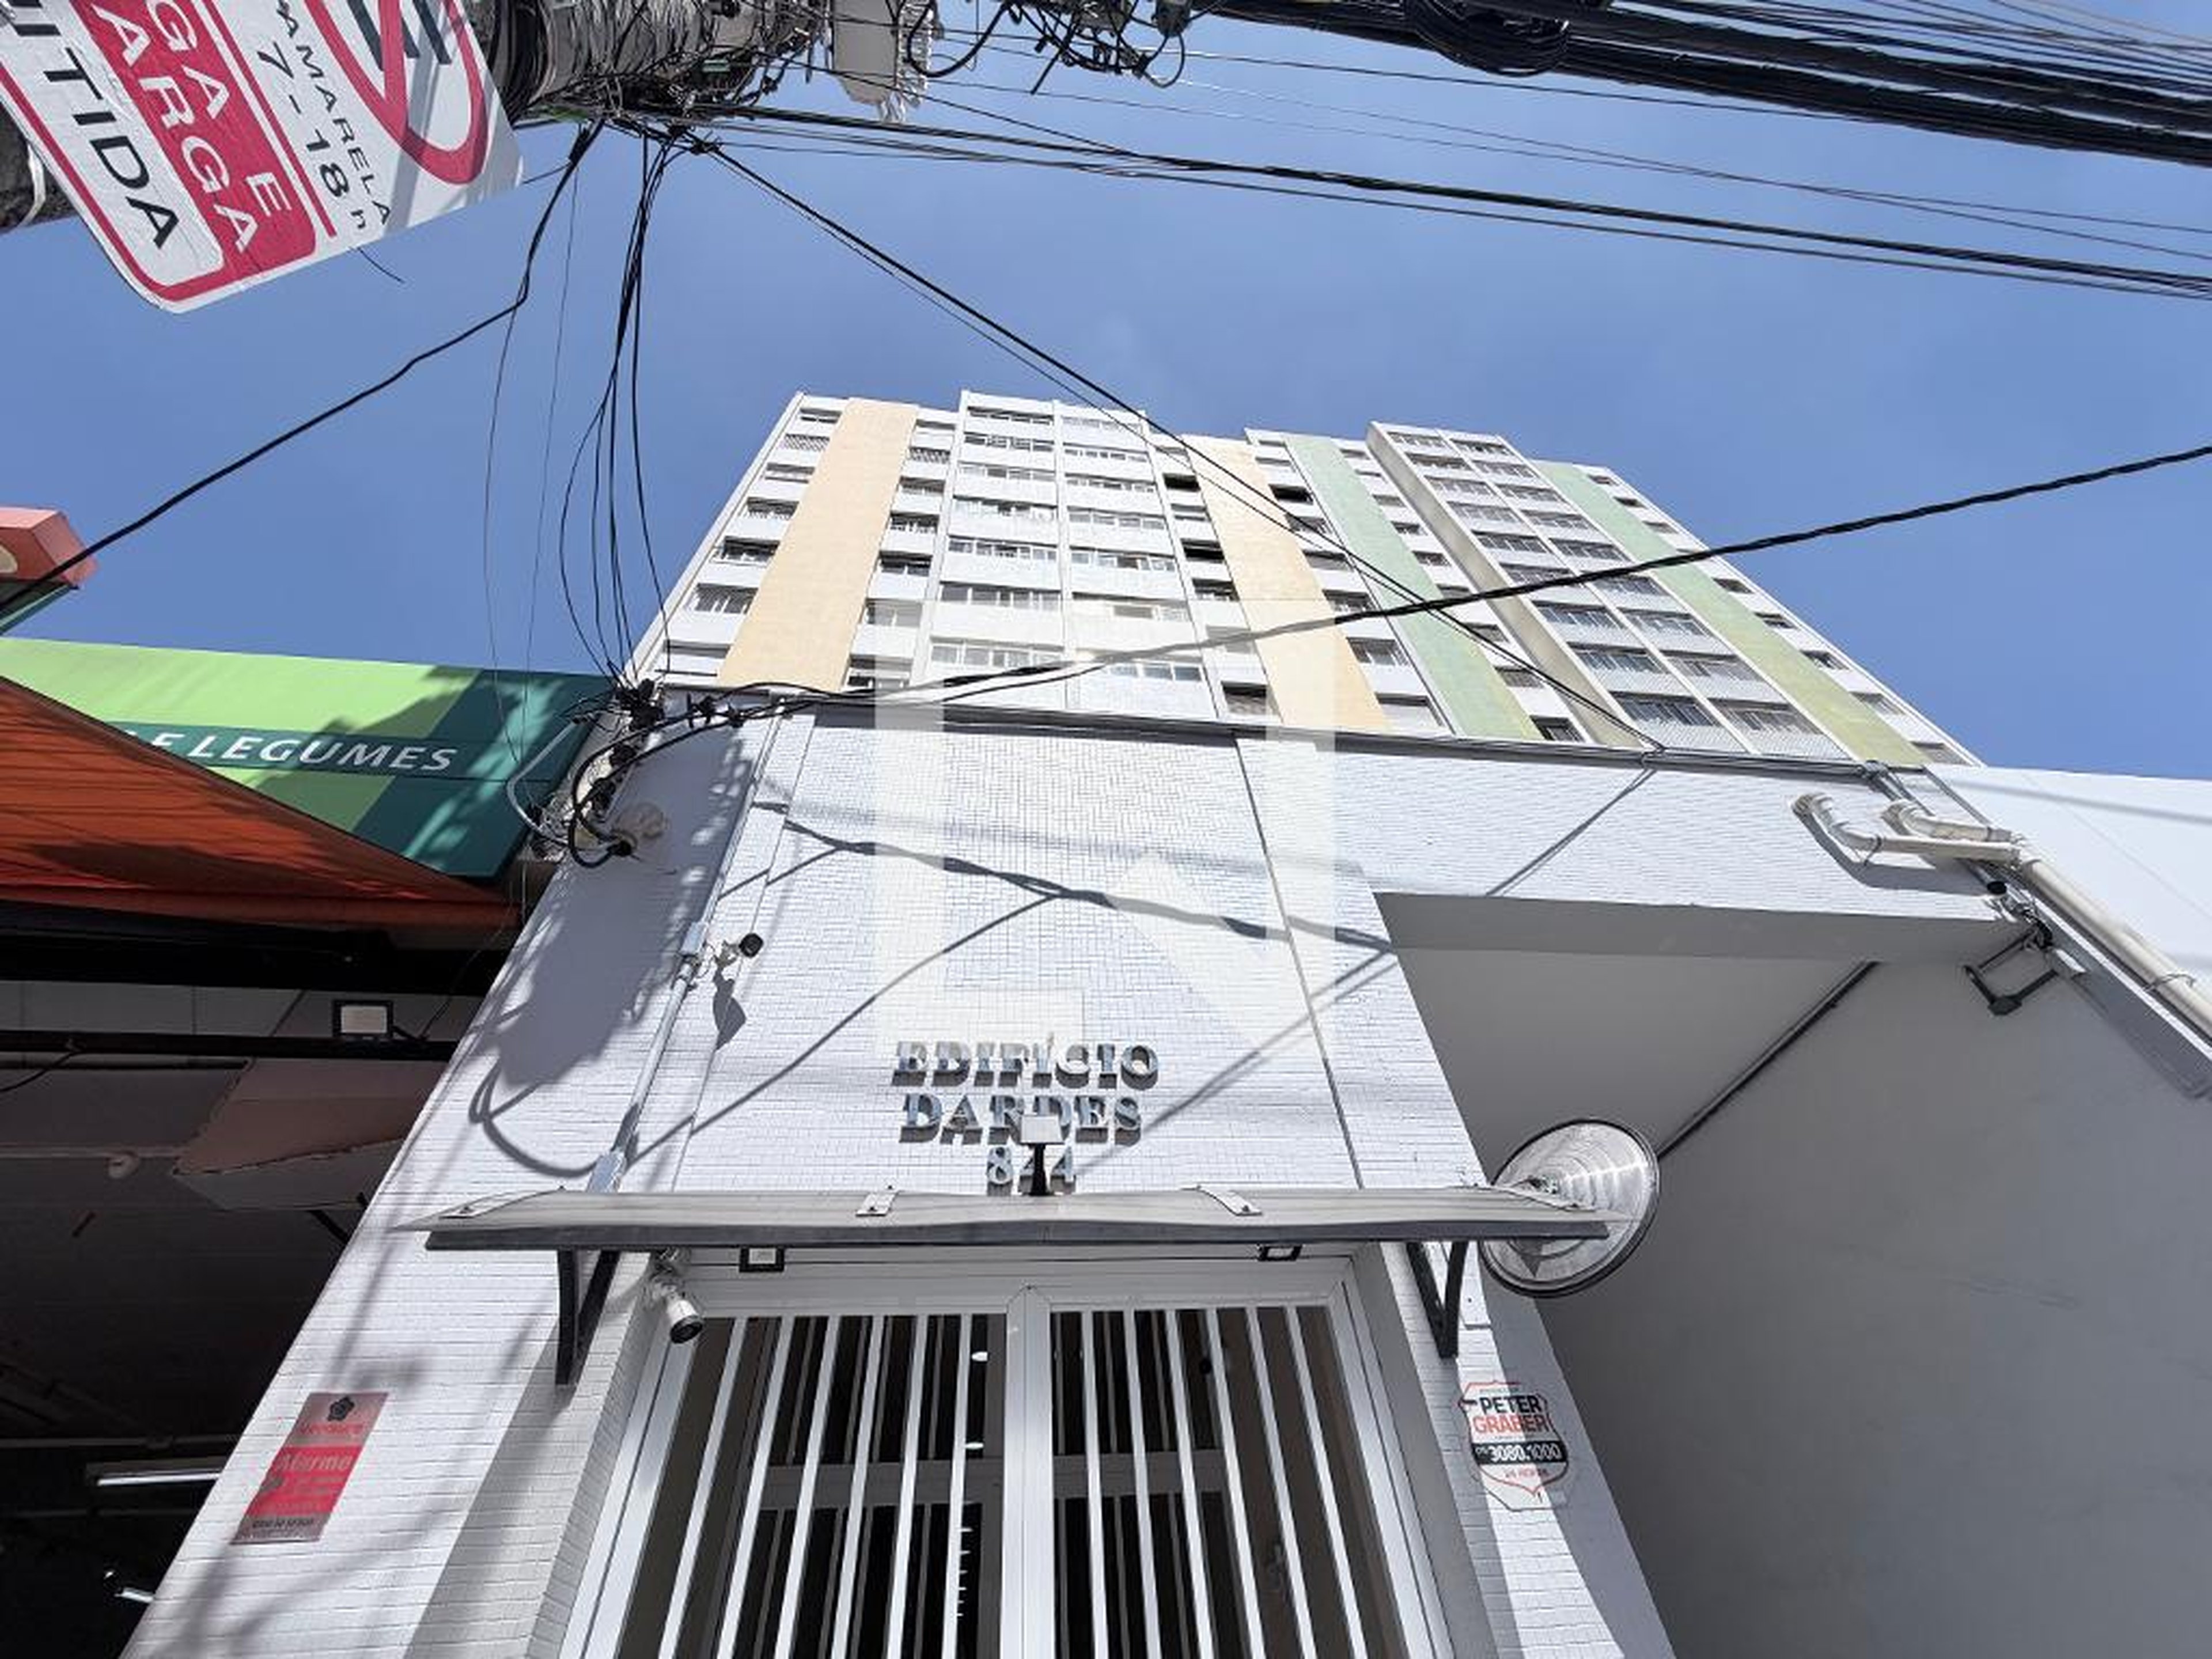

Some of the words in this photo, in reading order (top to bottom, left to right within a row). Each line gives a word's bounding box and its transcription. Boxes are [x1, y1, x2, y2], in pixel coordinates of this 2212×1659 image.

[6, 0, 179, 249] ITIDA
[276, 9, 391, 225] AMARELA
[244, 172, 290, 217] E
[187, 735, 459, 771] LEGUMES
[892, 1033, 1158, 1089] EDIFÍCIO
[1472, 1414, 1550, 1434] GRABER
[1479, 1395, 1542, 1414] PETER
